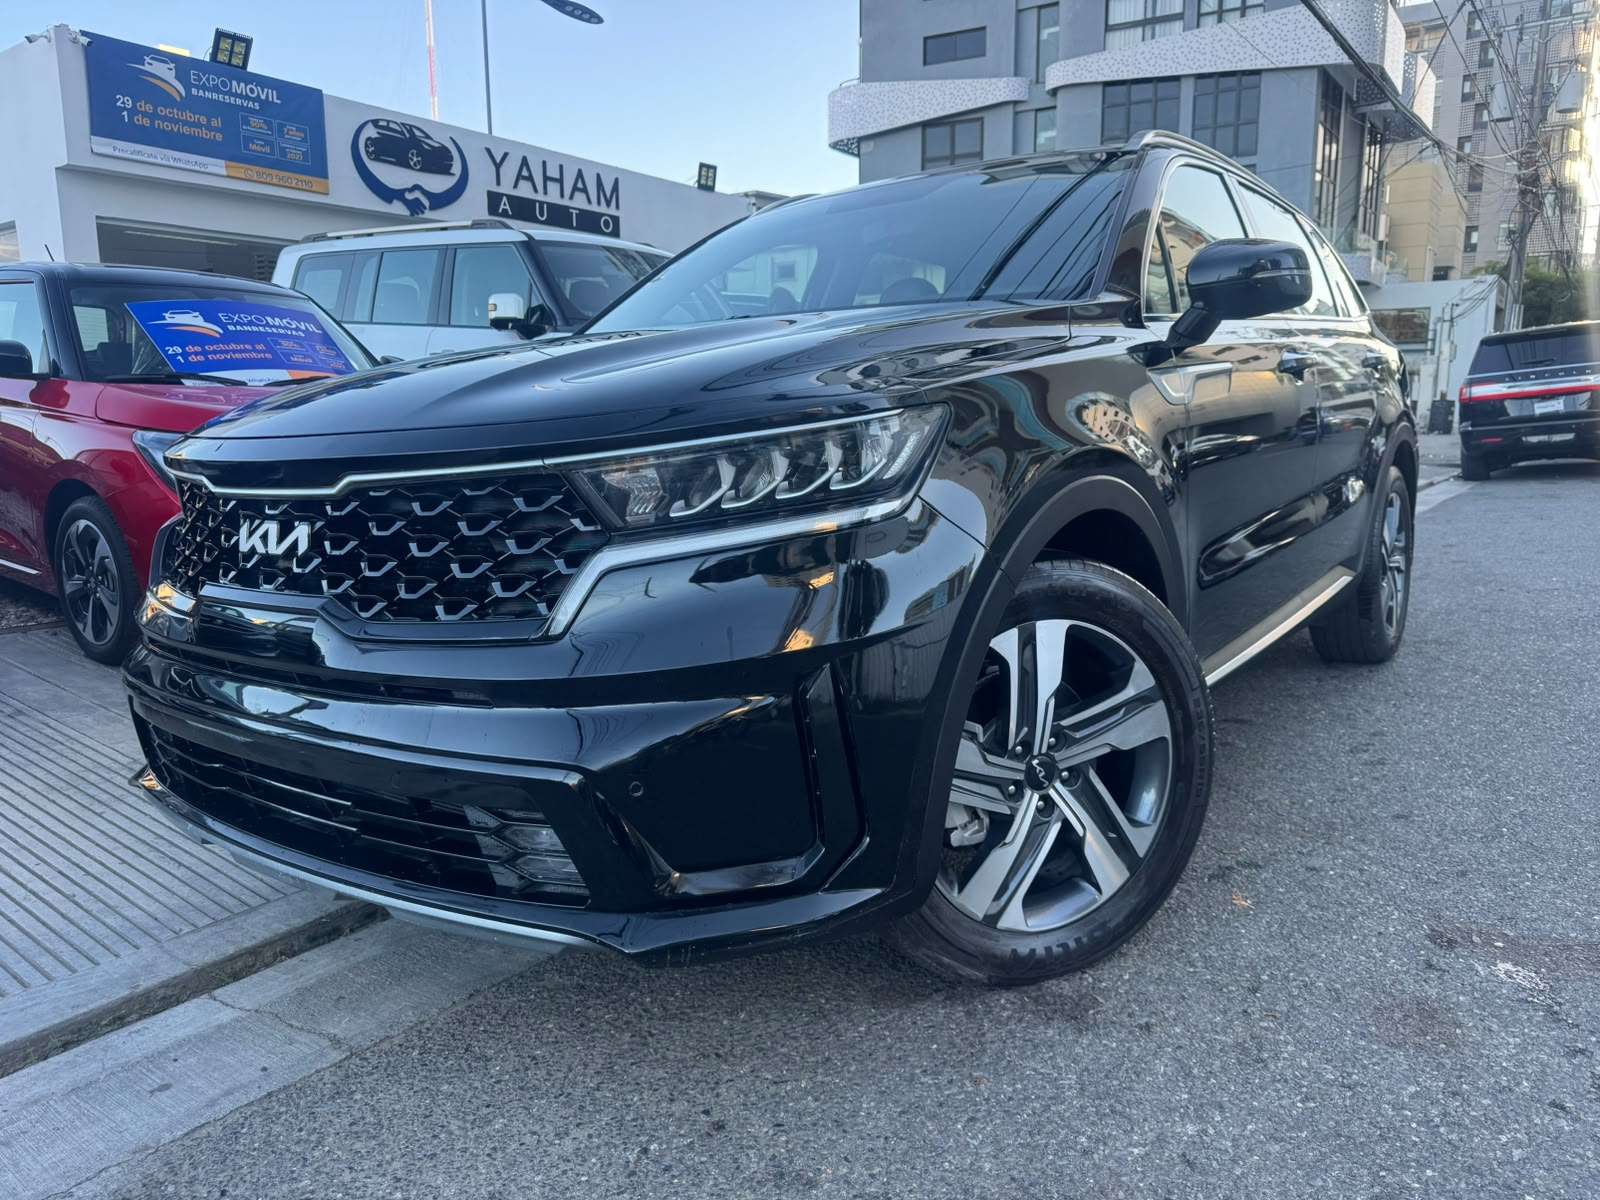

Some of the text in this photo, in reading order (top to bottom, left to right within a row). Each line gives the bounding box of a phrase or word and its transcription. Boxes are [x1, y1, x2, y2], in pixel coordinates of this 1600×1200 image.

[190, 70, 282, 104] EXPOMÓVIL
[191, 87, 260, 110] BANRESERVAS
[115, 94, 222, 128] 29 de octubre al
[121, 110, 224, 142] 1 de noviembre
[484, 147, 620, 210] YAHAM
[499, 196, 613, 232] AUTO
[218, 312, 322, 334] EXPOMÓVIL
[227, 325, 305, 337] BANRESERVAS
[165, 343, 266, 355] 29 de octubre al
[176, 351, 273, 364] 1 de noviembre
[238, 519, 310, 556] KIA
